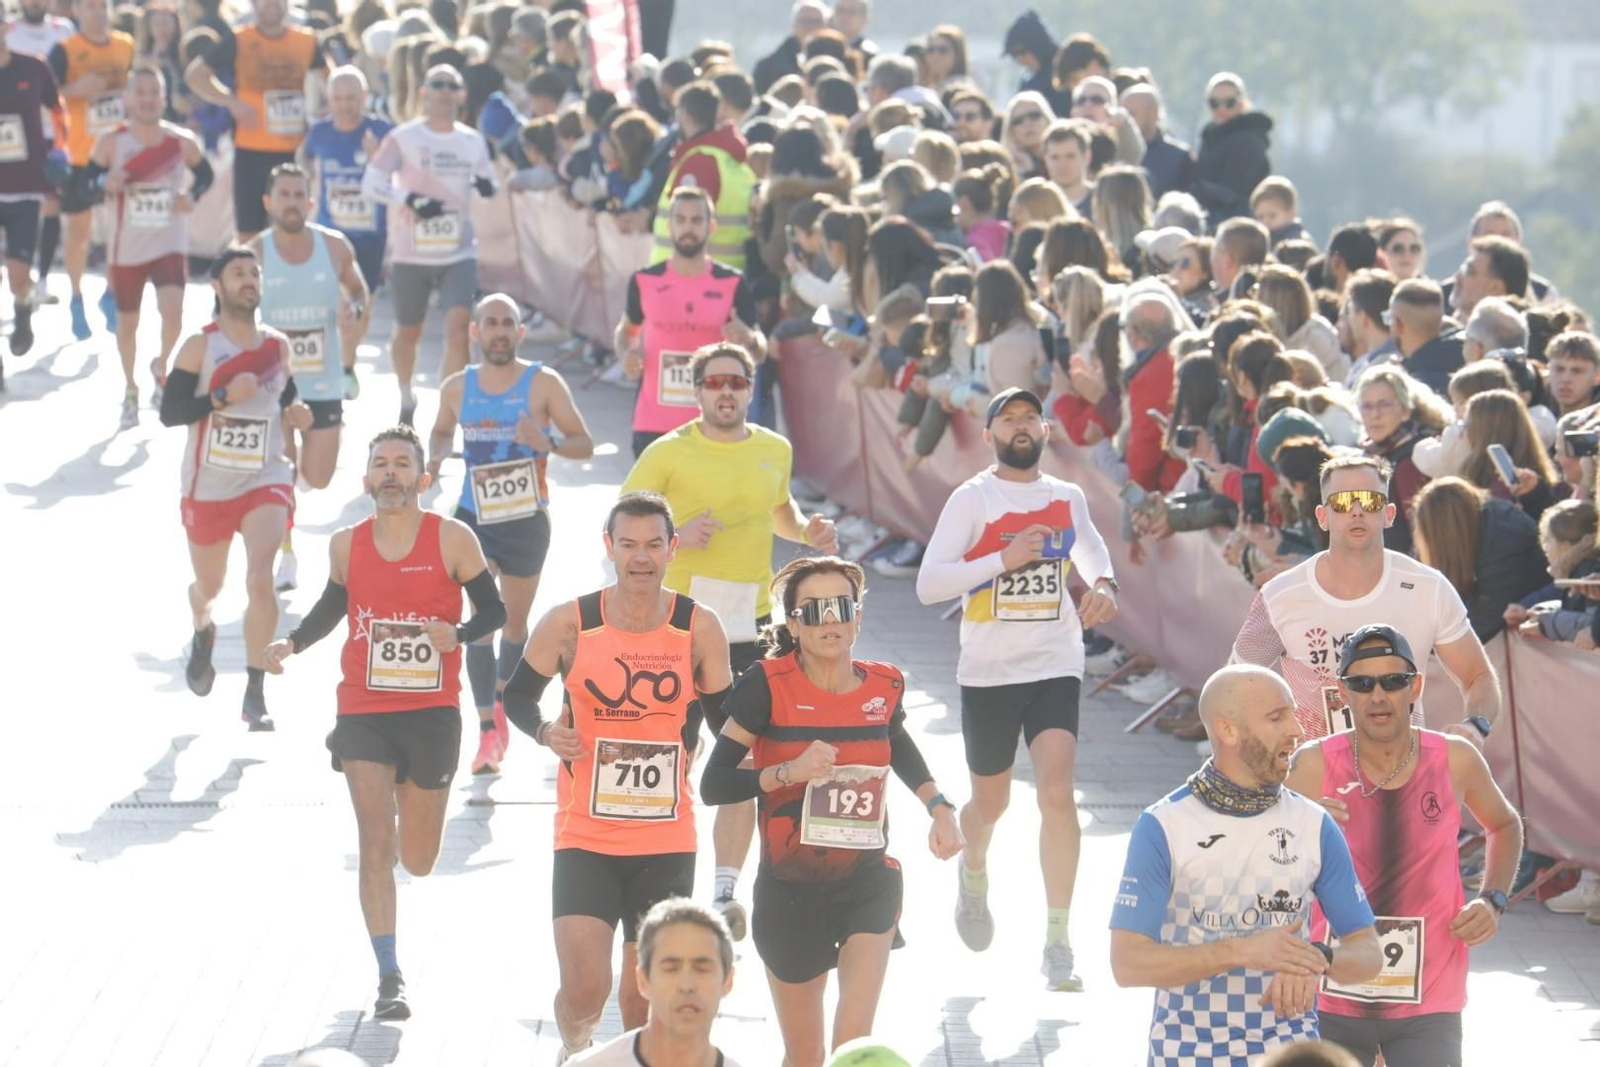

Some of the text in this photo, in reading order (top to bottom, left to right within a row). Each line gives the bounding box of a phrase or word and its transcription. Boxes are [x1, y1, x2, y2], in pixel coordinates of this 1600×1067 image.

[217, 428, 259, 449] 1223
[480, 476, 529, 498] 1209
[1000, 575, 1058, 596] 2235
[381, 642, 432, 663] 850
[1310, 649, 1329, 665] 37
[605, 708, 640, 718] Serrano
[615, 763, 661, 789] 710
[828, 788, 874, 816] 193
